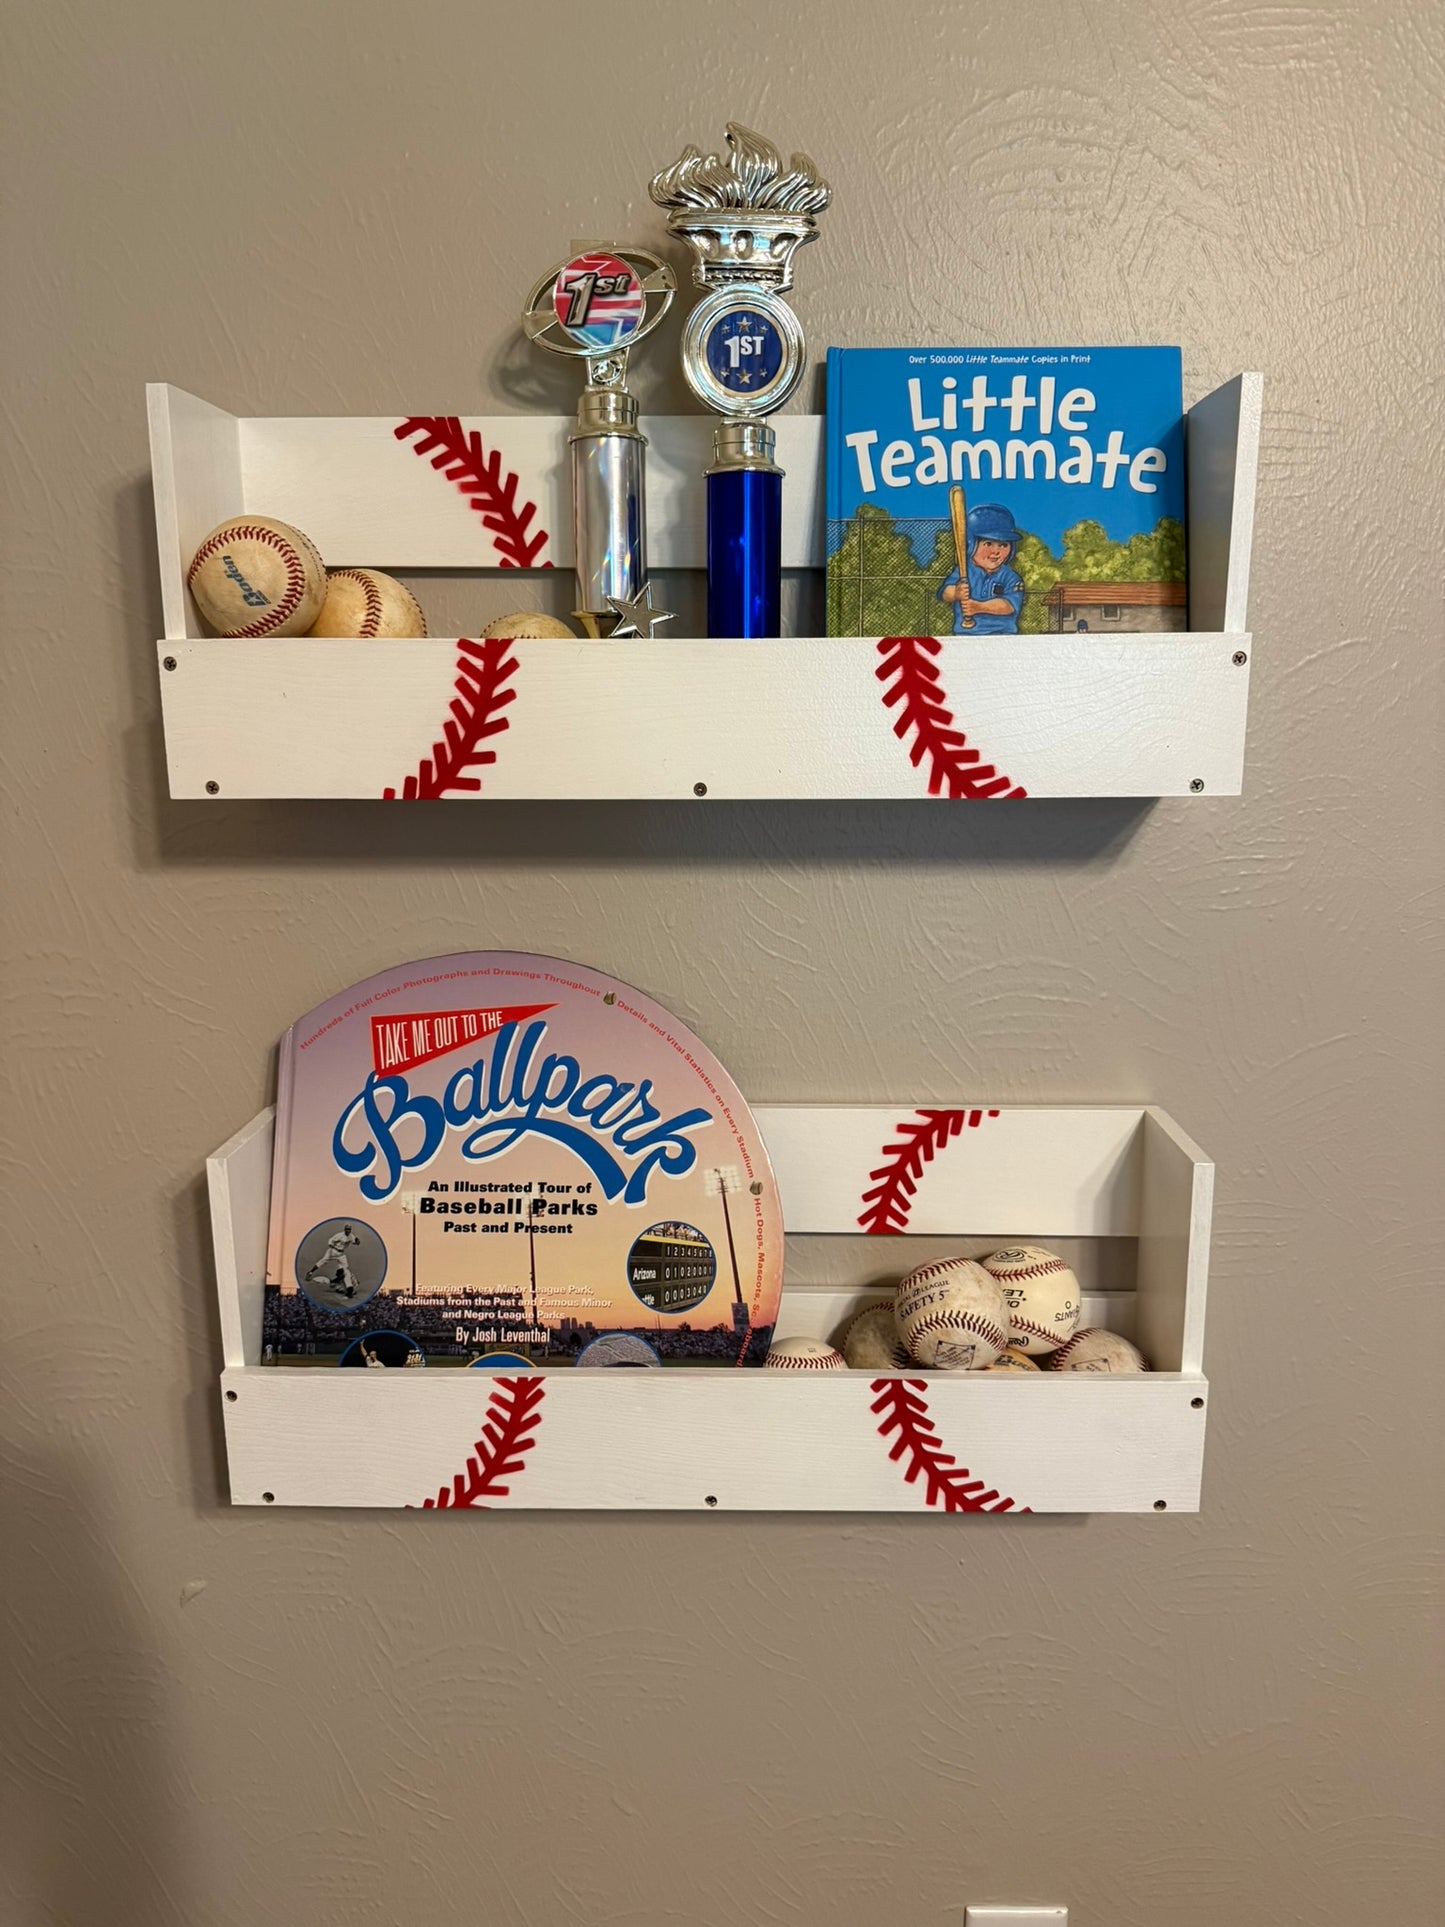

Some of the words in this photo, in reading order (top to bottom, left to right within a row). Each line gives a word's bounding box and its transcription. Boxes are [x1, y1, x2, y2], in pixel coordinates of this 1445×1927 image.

[565, 272, 632, 327] 1st
[724, 335, 765, 368] 1ST
[909, 355, 927, 364] Over
[966, 355, 988, 364] Little
[990, 354, 1029, 364] Teammate
[1031, 354, 1058, 364] Copies
[1061, 354, 1069, 363] in
[1070, 354, 1091, 363] Print
[907, 375, 1096, 434] Little
[845, 430, 1167, 493] Teammate
[300, 1015, 344, 1050] Hundreds
[344, 1008, 355, 1018] of
[354, 998, 374, 1012] Full
[374, 987, 401, 1001] Color
[402, 971, 469, 990] Photographs
[471, 968, 491, 976] and
[493, 968, 541, 980] Drawings
[544, 973, 601, 997] Throughout
[375, 1021, 411, 1070] TAKE
[412, 1019, 433, 1058] ME
[434, 1015, 459, 1050] OUT
[461, 1013, 478, 1039] TO
[479, 1010, 504, 1033] THE
[617, 1000, 648, 1024] Details
[649, 1022, 667, 1037] and
[666, 1035, 686, 1055] Vital
[684, 1053, 717, 1095] Statistics
[715, 1094, 725, 1107] on
[723, 1107, 739, 1135] Every
[736, 1135, 754, 1179] Stadium
[332, 1020, 716, 1206] Ballpark
[427, 1181, 449, 1192] An
[454, 1180, 533, 1193] Illustrated
[537, 1181, 572, 1193] Tour
[576, 1182, 592, 1194] of
[420, 1197, 522, 1214] Baseball
[532, 1198, 598, 1216] Parks
[753, 1197, 763, 1217] Hot
[443, 1221, 478, 1233] Past
[481, 1222, 509, 1233] and
[514, 1222, 573, 1234] Present
[756, 1219, 764, 1250] Dogs,
[632, 1267, 656, 1281] Arizona
[753, 1252, 765, 1301] Mascots,
[415, 1285, 464, 1296] Featuring
[466, 1285, 496, 1296] Every
[497, 1285, 527, 1296] Major
[530, 1285, 566, 1297] League
[568, 1285, 594, 1297] Park,
[921, 1280, 950, 1293] LEAGUE
[396, 1295, 445, 1306] Stadiums
[447, 1296, 472, 1306] from
[474, 1296, 491, 1306] the
[493, 1296, 516, 1307] Past
[517, 1296, 537, 1307] and
[539, 1297, 579, 1307] Famous
[581, 1297, 613, 1308] Minor
[899, 1292, 936, 1320] SAFETY
[442, 1310, 462, 1319] and
[464, 1310, 496, 1320] Negro
[497, 1310, 535, 1320] League
[537, 1310, 565, 1320] Parks
[456, 1327, 469, 1345] By
[472, 1327, 498, 1343] Josh
[501, 1327, 550, 1343] Leventhal
